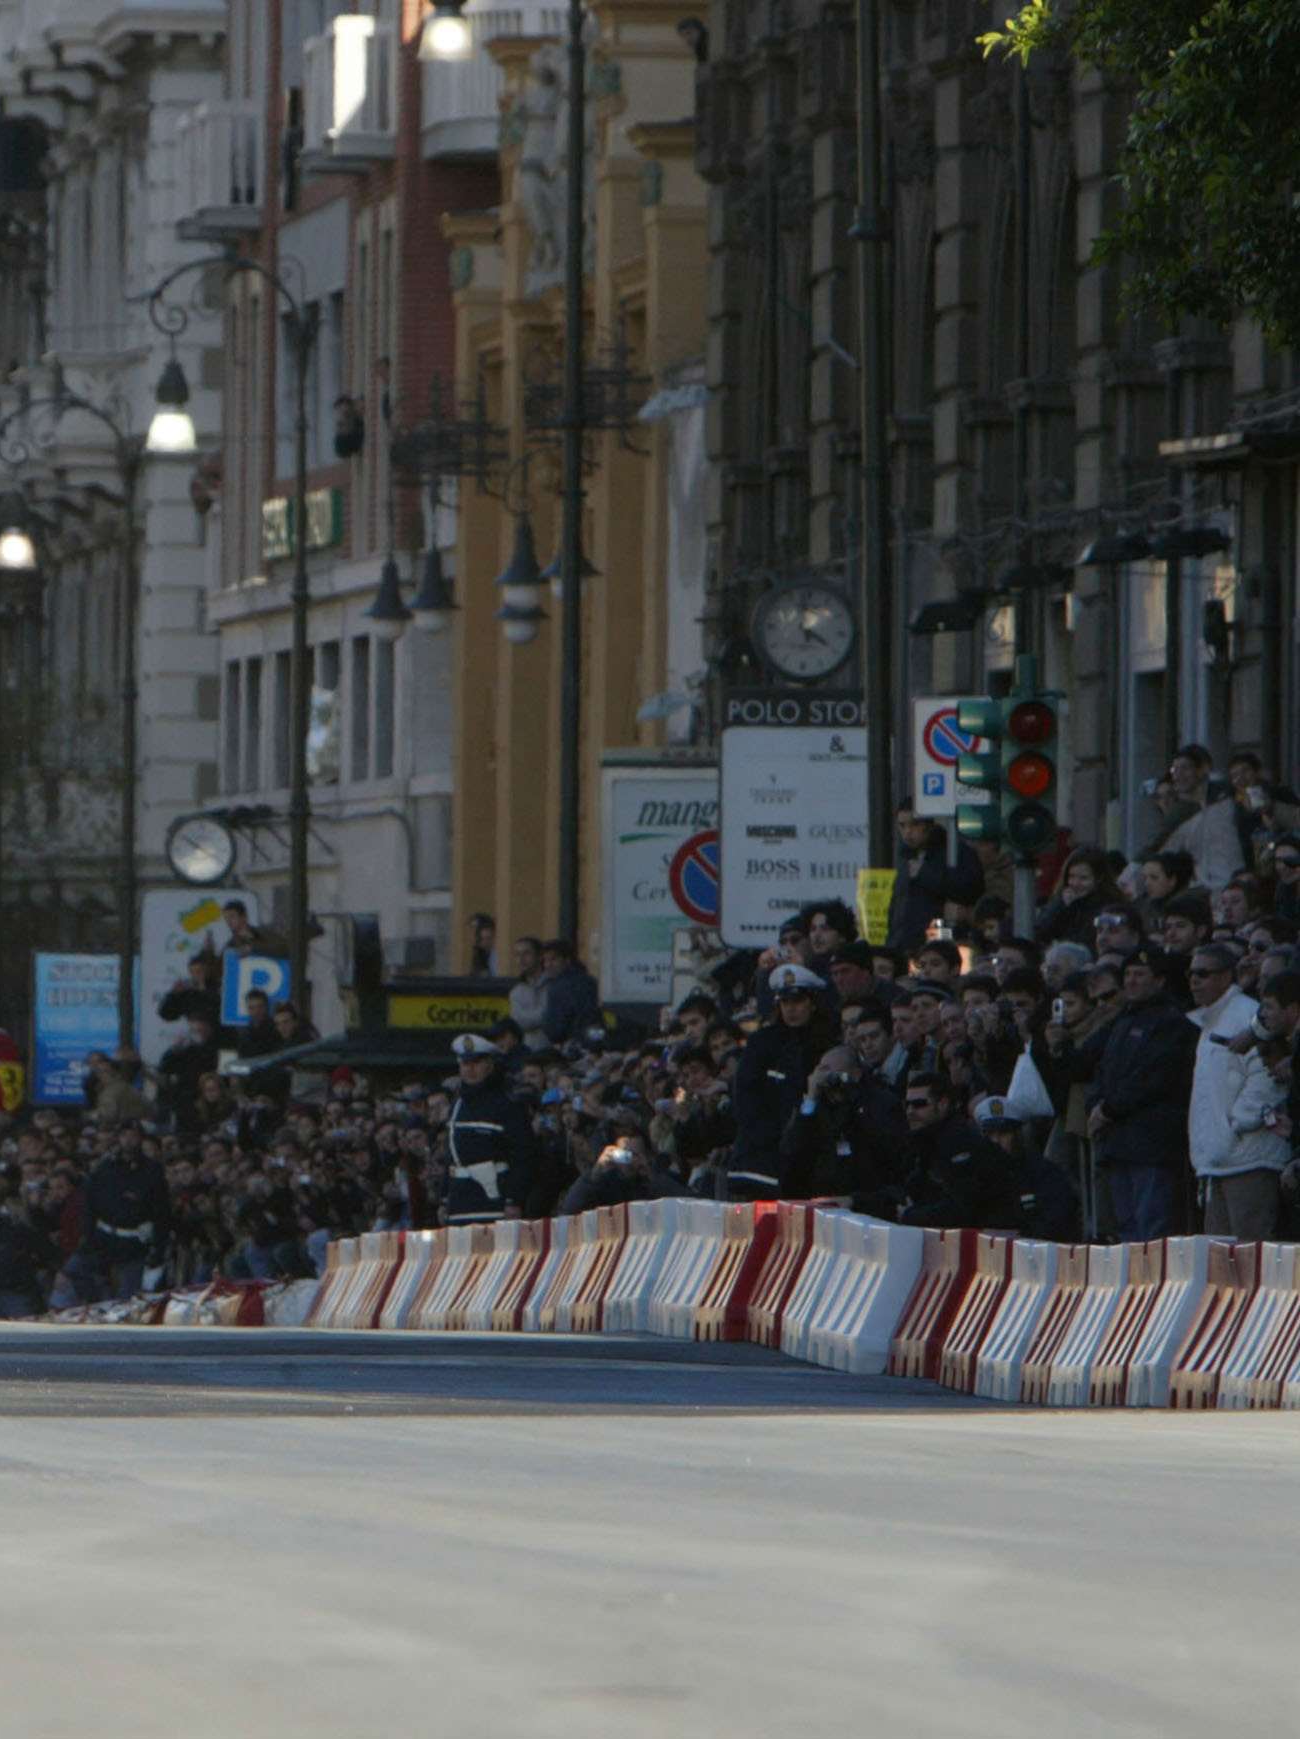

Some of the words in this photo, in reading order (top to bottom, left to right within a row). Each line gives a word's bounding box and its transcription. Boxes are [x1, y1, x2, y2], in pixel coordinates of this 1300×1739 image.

[727, 700, 801, 724] POLO
[927, 770, 941, 794] P
[746, 859, 800, 875] BOSS
[237, 955, 284, 1017] P
